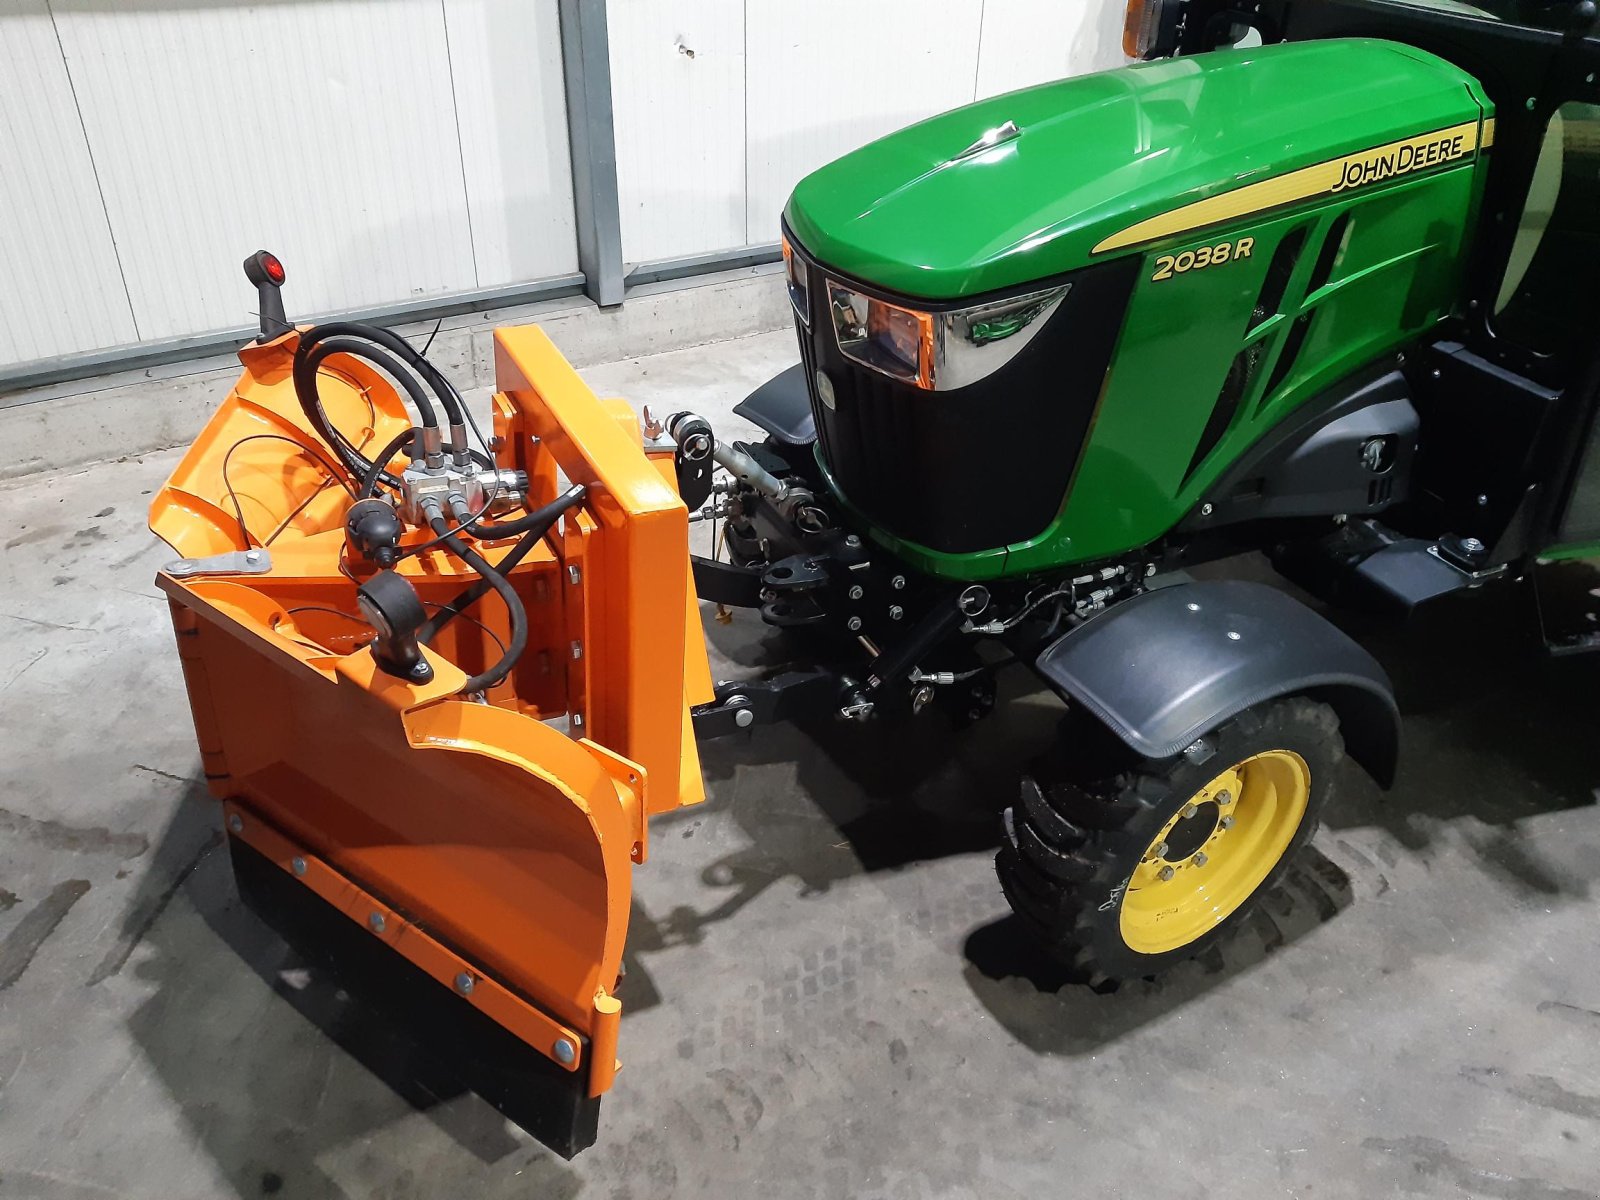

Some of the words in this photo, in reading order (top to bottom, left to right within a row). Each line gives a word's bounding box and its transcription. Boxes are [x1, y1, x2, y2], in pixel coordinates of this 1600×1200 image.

[1331, 153, 1395, 190] JOHN
[1397, 135, 1464, 172] DEERE
[1151, 242, 1232, 281] 2038
[1234, 237, 1254, 260] R
